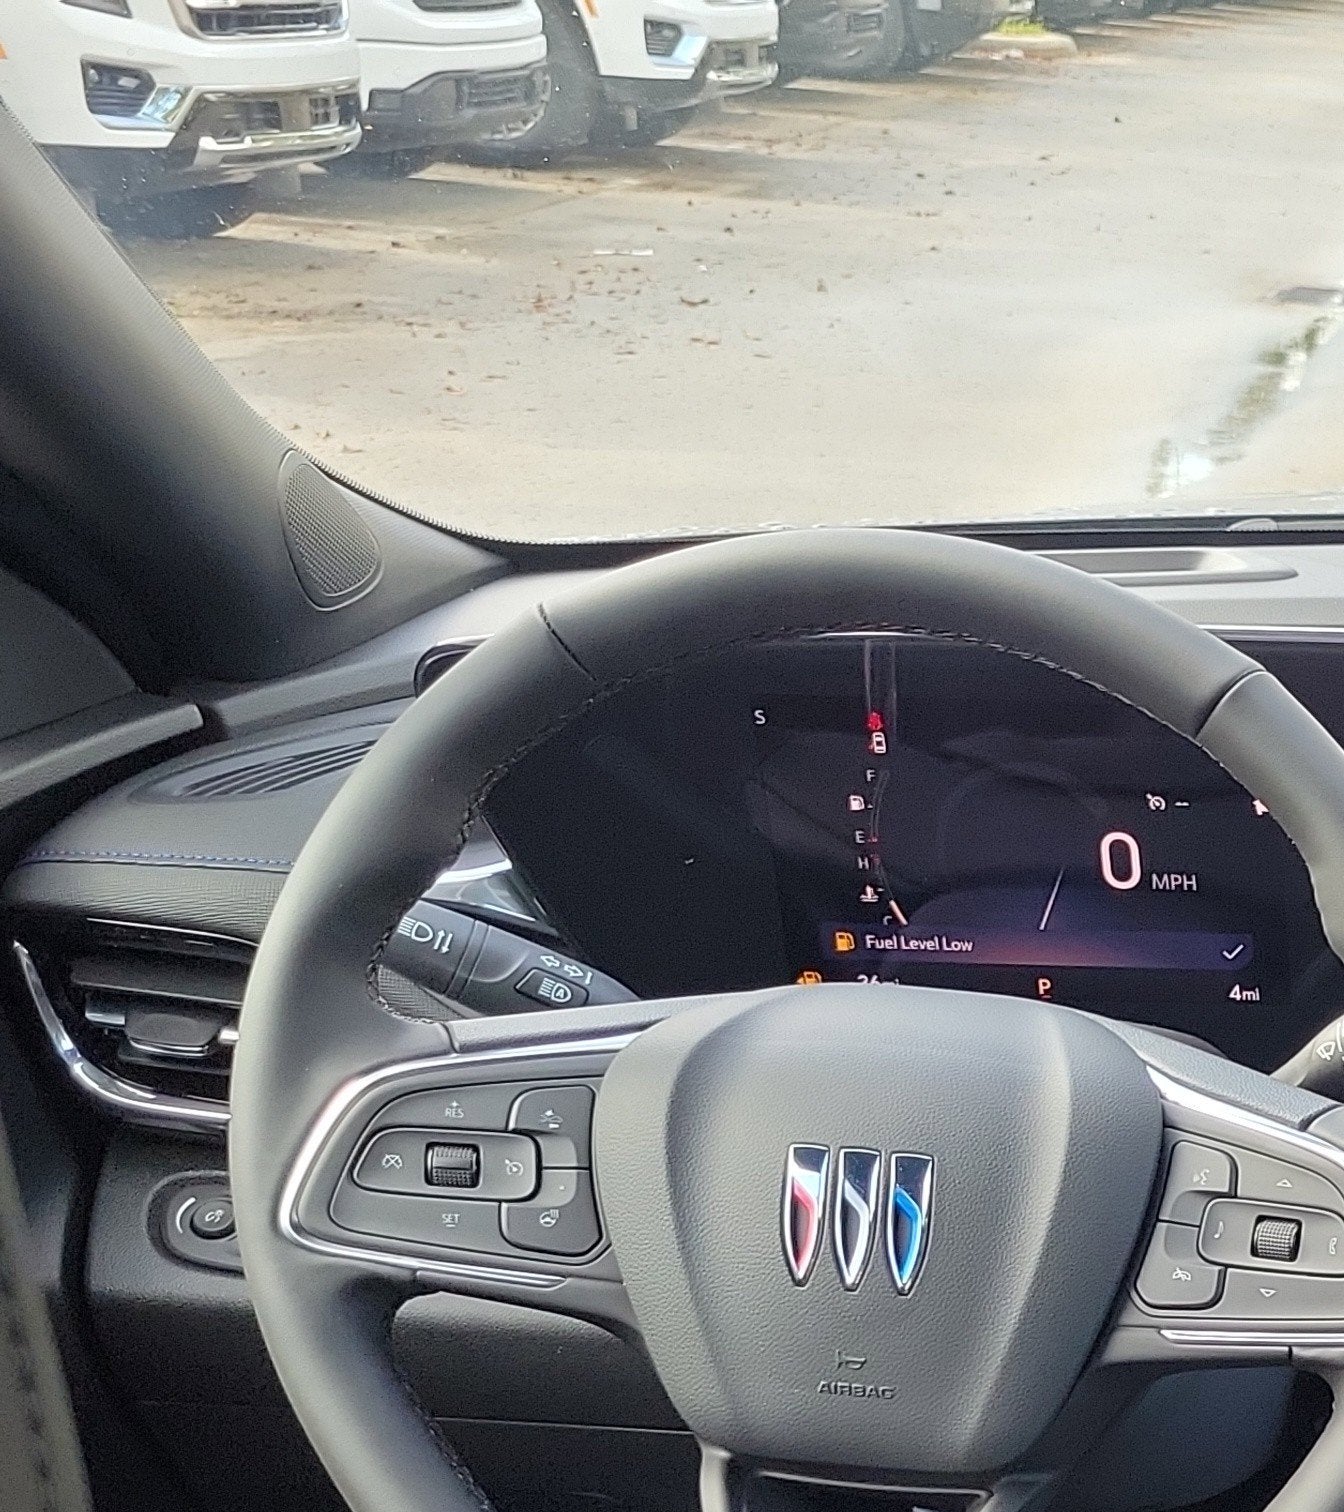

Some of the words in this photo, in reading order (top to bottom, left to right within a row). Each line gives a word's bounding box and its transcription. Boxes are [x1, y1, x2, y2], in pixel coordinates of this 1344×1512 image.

[754, 709, 767, 725] S
[866, 769, 876, 782] F
[855, 830, 866, 844] E
[857, 856, 870, 870] H
[1100, 831, 1142, 890] 0
[1151, 873, 1198, 891] MPH
[864, 933, 898, 950] Fuel
[901, 934, 940, 951] Level
[942, 936, 974, 952] Low
[1037, 977, 1052, 995] P
[1228, 983, 1261, 1002] 4mi
[445, 1107, 465, 1119] RES
[442, 1213, 460, 1224] SET
[817, 1380, 898, 1400] AIRBAG
